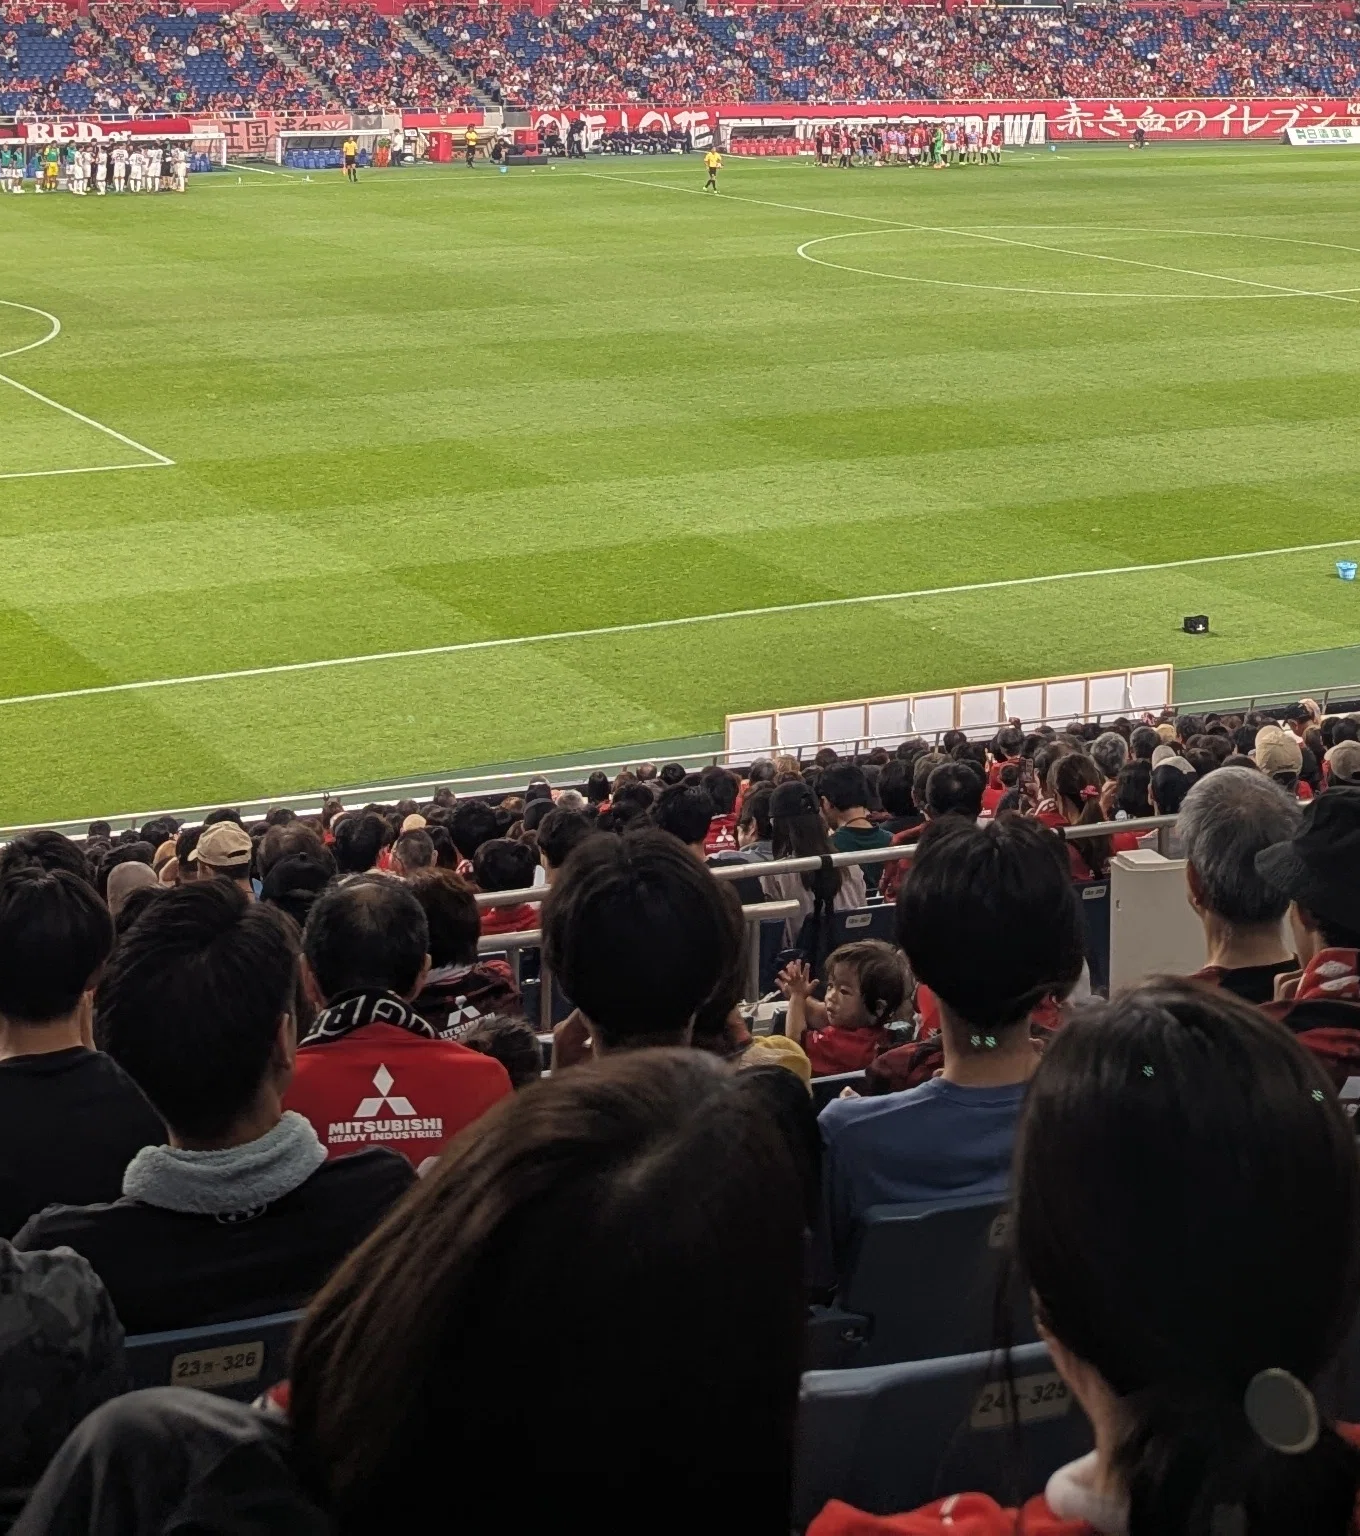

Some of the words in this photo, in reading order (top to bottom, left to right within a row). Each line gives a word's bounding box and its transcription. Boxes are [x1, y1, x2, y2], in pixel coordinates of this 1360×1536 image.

[1055, 101, 1337, 138] 赤き血のイレブン
[26, 122, 103, 141] RED
[327, 1117, 443, 1135] MITSUBISHI
[327, 1133, 367, 1144] HEAVY
[370, 1130, 443, 1142] INDUSTRIES
